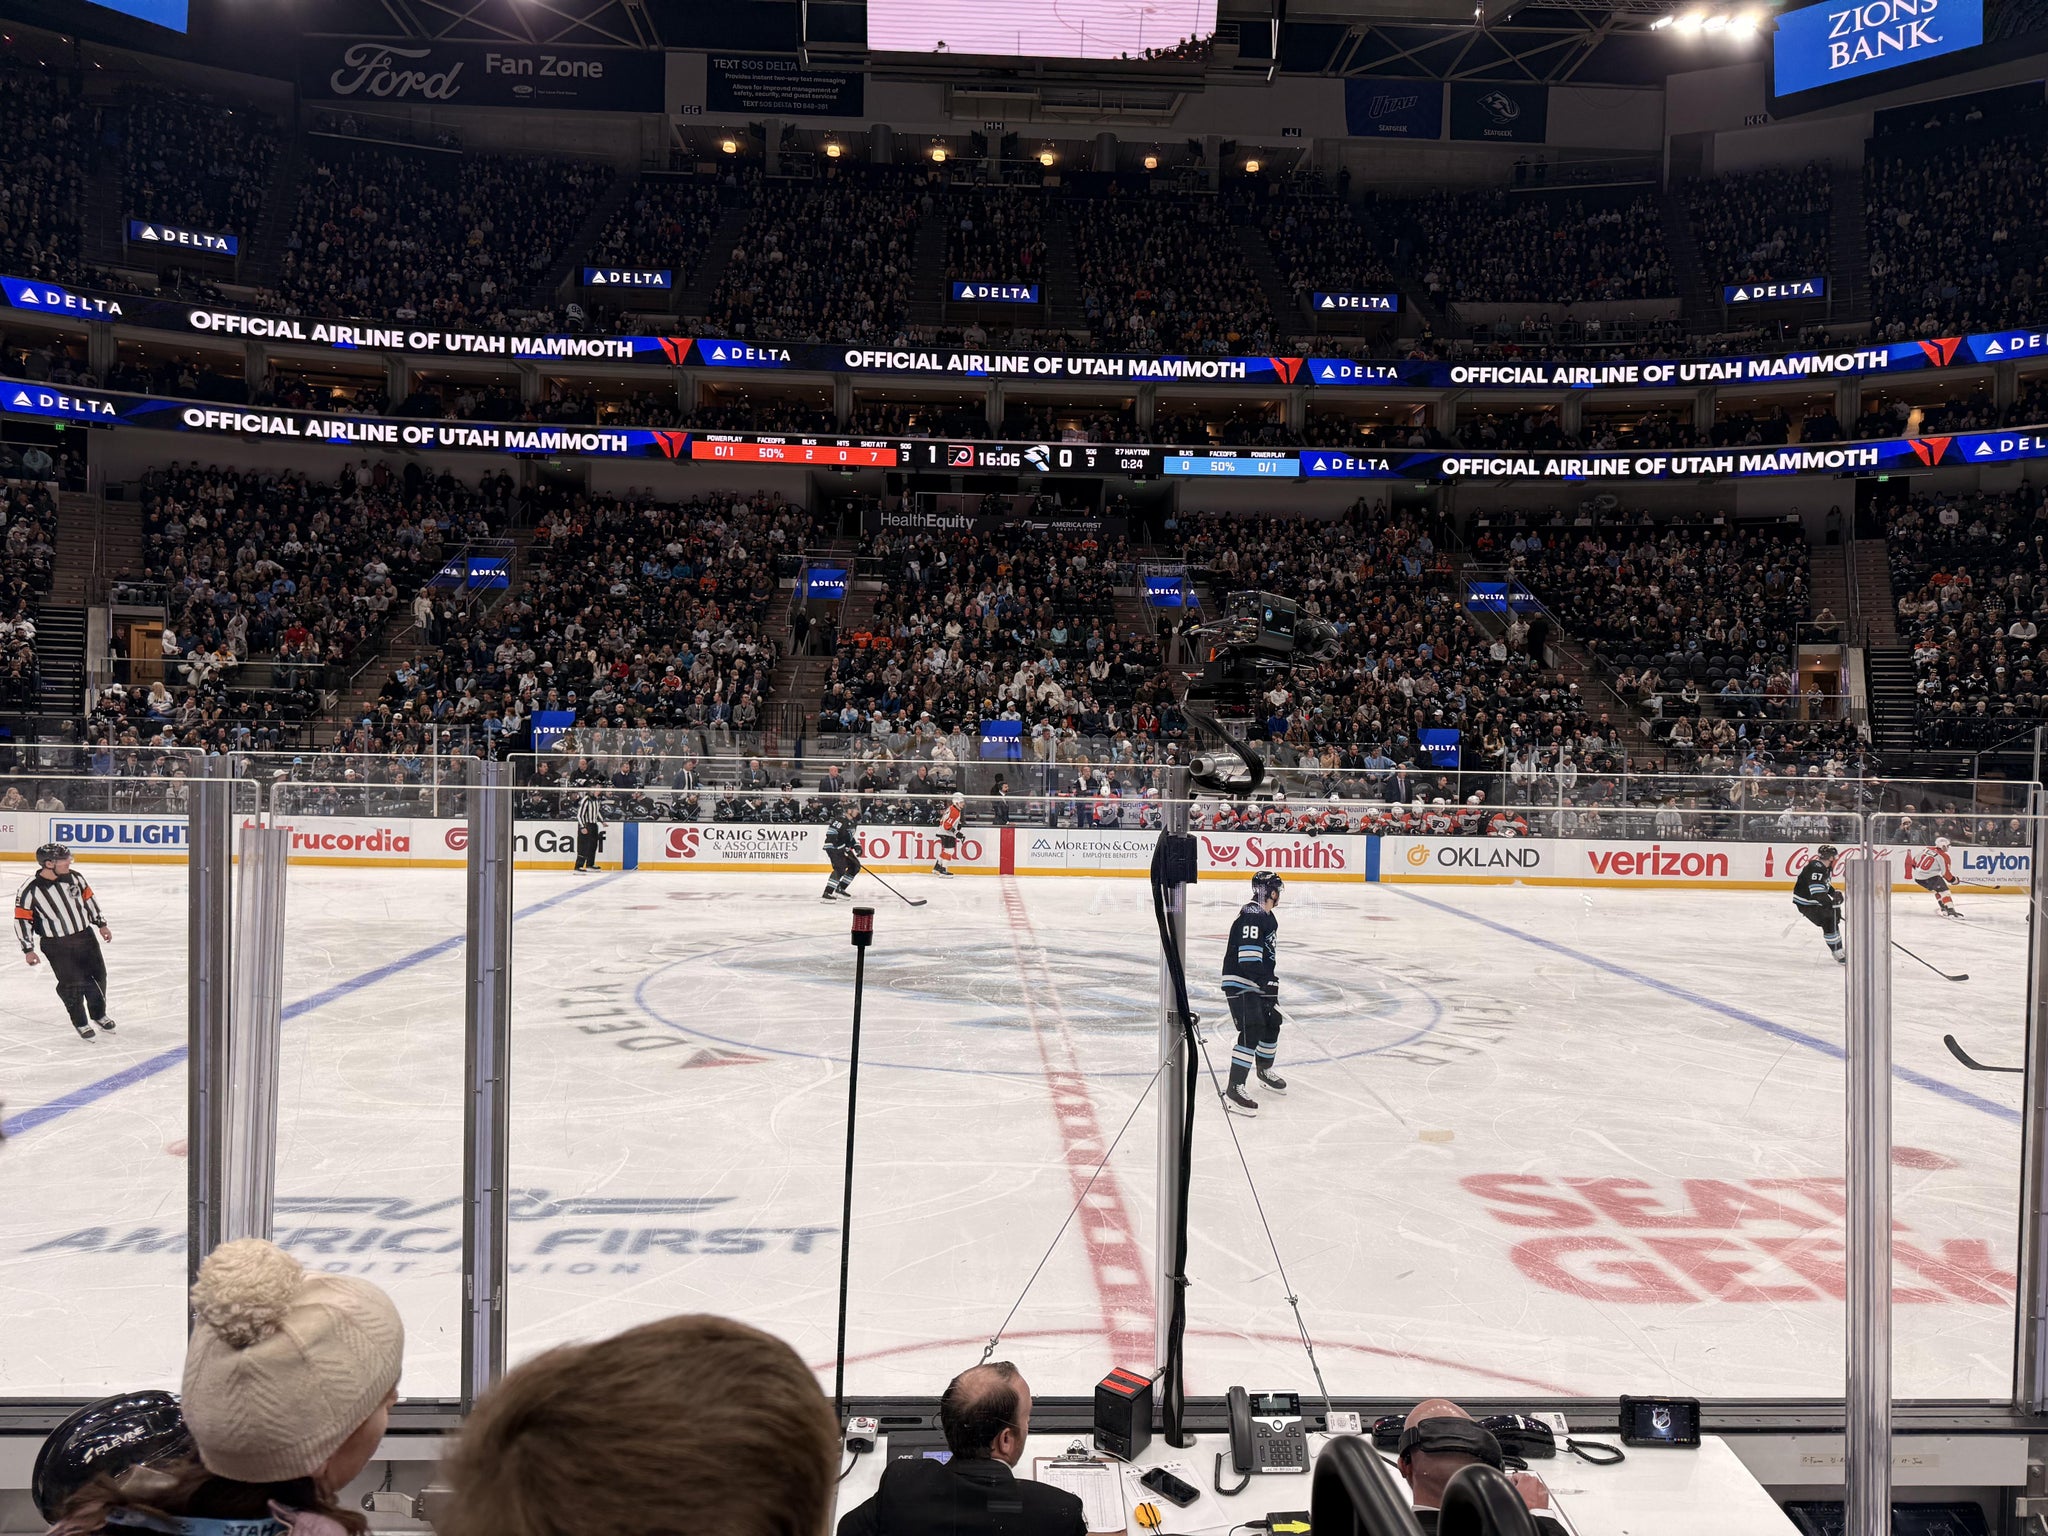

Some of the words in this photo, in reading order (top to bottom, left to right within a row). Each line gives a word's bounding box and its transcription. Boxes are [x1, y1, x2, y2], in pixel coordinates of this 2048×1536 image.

[1828, 0, 1938, 39] ZIONS
[1828, 16, 1938, 70] BANK
[330, 43, 464, 99] Ford
[486, 53, 533, 75] Fan
[540, 56, 604, 78] Zone
[713, 59, 740, 70] TEXT
[741, 60, 764, 70] SOS
[765, 61, 798, 71] DELTA
[813, 77, 846, 85] messaging
[683, 105, 700, 114] GG
[1368, 95, 1418, 119] UTAH
[986, 122, 1002, 130] HH
[1747, 114, 1764, 125] KK
[1285, 128, 1299, 137] JJ
[1378, 124, 1408, 133] SEATGEEK
[1483, 128, 1512, 137] SEATGEEK
[164, 230, 228, 250] DELTA
[610, 272, 663, 285] DELTA
[979, 287, 1030, 299] DELTA
[1753, 283, 1813, 298] DELTA
[46, 291, 123, 315] DELTA
[1339, 297, 1390, 308] DELTA
[190, 310, 306, 340] OFFICIAL
[311, 324, 404, 348] AIRLINE
[408, 331, 440, 350] OF
[445, 333, 505, 353] UTAH
[510, 337, 633, 357] MAMMOTH
[2011, 334, 2048, 350] DE
[732, 348, 791, 361] DELTA
[844, 350, 942, 370] OFFICIAL
[947, 354, 1029, 373] AIRLINE
[1033, 358, 1063, 374] OF
[1067, 358, 1123, 376] UTAH
[1129, 360, 1245, 378] MAMMOTH
[1450, 366, 1548, 383] OFFICIAL
[1553, 366, 1638, 383] AIRLINE
[1643, 365, 1675, 382] OF
[1680, 361, 1741, 381] UTAH
[1748, 350, 1888, 377] MAMMOTH
[1341, 366, 1398, 379] DELTA
[39, 394, 117, 415] DELTA
[183, 408, 300, 436] OFFICIAL
[305, 419, 398, 442] AIRLINE
[402, 425, 435, 444] OF
[439, 428, 499, 447] UTAH
[504, 431, 628, 452] MAMMOTH
[715, 446, 734, 457] 0/1
[2001, 437, 2045, 452] DEL
[759, 448, 784, 459] 50%
[806, 450, 813, 459] 2
[840, 451, 847, 461] 0
[871, 452, 877, 462] 7
[902, 451, 910, 461] 3
[929, 446, 936, 463] 1
[979, 452, 1020, 466] 16:06
[1060, 449, 1072, 467] 0
[1088, 457, 1095, 467] 3
[1121, 459, 1143, 469] 0:24
[1183, 461, 1190, 471] 0
[1210, 461, 1235, 471] 50%
[1258, 462, 1276, 472] 0/1
[1332, 459, 1390, 470] DELTA
[1442, 458, 1540, 475] OFFICIAL
[1544, 459, 1630, 475] AIRLINE
[1634, 458, 1666, 475] OF
[1671, 456, 1733, 473] UTAH
[1739, 448, 1878, 472] MAMMOTH
[880, 512, 974, 530] HealthEquity
[55, 824, 114, 842] BUD
[703, 827, 752, 841] CRAIG
[757, 828, 808, 841] SWAPP
[535, 830, 606, 853] Gaf
[713, 841, 719, 851] &
[721, 841, 798, 852] ASSOCIATES
[858, 831, 890, 859] io
[1054, 841, 1111, 851] MORETON
[1113, 841, 1121, 851] &
[1123, 841, 1156, 851] COMP
[722, 851, 747, 860] INJURY
[749, 852, 789, 860] ATTORNEYS
[1031, 851, 1064, 859] INSURANCE
[1245, 837, 1345, 869] Smith's
[1437, 847, 1540, 868] OKLAND
[1588, 844, 1728, 876] verizon
[1963, 851, 2029, 874] Layton
[1811, 873, 1822, 881] 67
[1242, 925, 1258, 939] 98
[1459, 1173, 1912, 1232] SEAT
[533, 1226, 838, 1255] FIRST
[512, 1261, 642, 1274] NION
[95, 1425, 146, 1455] FILEVINE
